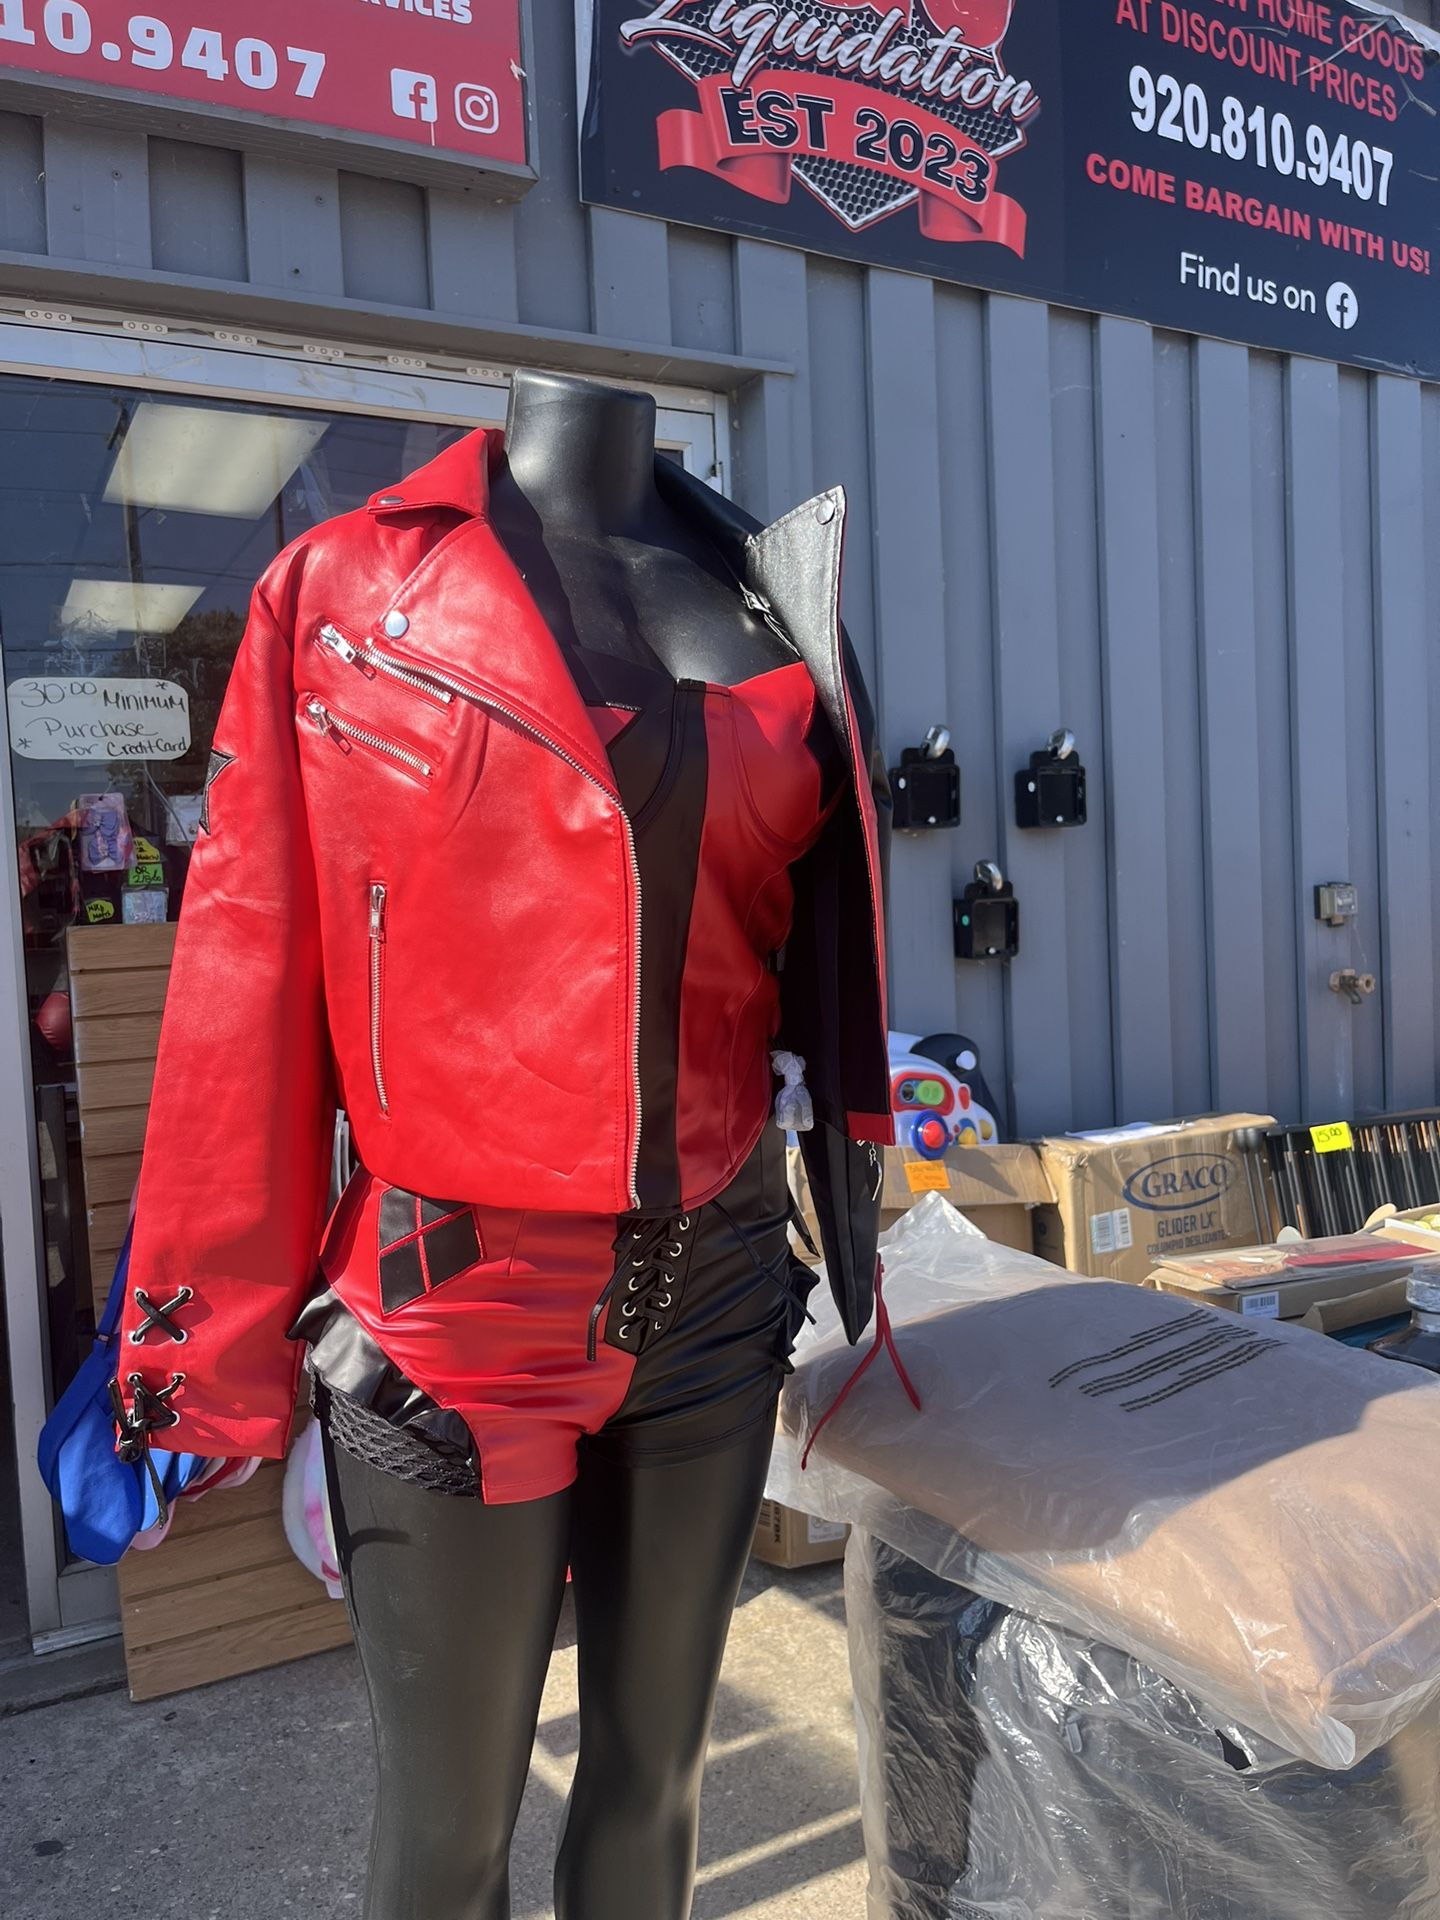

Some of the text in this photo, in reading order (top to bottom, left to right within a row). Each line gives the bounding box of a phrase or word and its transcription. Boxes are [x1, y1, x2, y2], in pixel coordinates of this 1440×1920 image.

[1116, 0, 1398, 122] AT DISCOUNT PRICES
[1339, 14, 1425, 81] GOODS
[720, 87, 991, 204] EST 2023
[1128, 65, 1393, 206] 920.810.9407
[1086, 153, 1432, 276] COME BARGAIN WITH US!
[1180, 252, 1316, 314] Find us on
[25, 717, 159, 739] Purchase
[58, 742, 99, 757] for
[1142, 1163, 1228, 1198] GRACO
[1157, 1215, 1197, 1238] GLIDER
